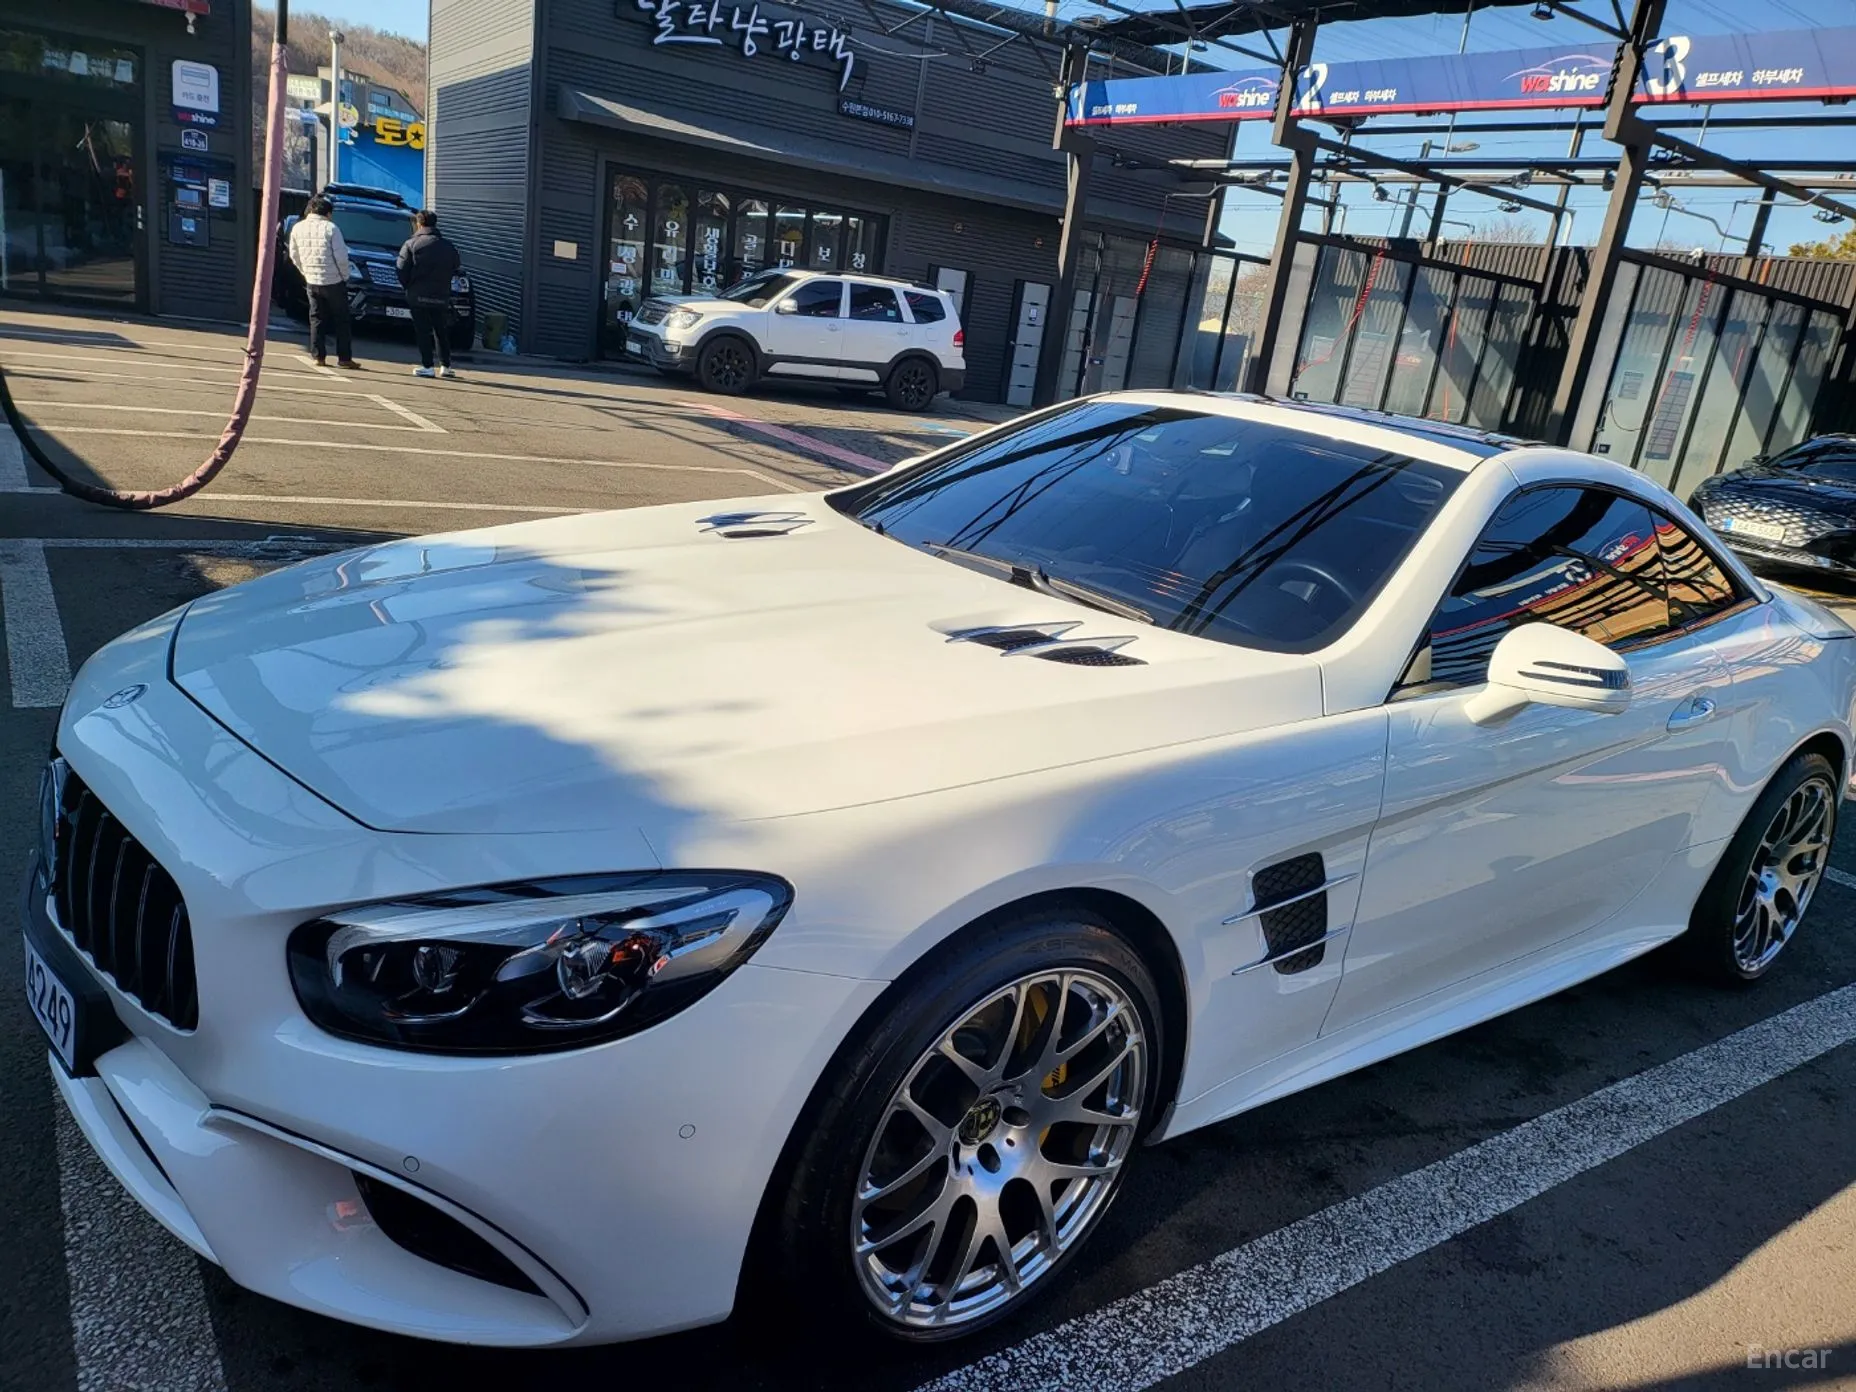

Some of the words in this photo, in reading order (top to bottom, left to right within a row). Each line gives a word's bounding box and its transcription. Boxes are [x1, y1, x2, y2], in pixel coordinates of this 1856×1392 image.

[1301, 63, 1328, 110] 2
[1521, 67, 1599, 95] washine
[1650, 36, 1690, 95] 3
[1695, 71, 1743, 87] 셀프세차
[1752, 68, 1804, 85] 하부세차
[1219, 86, 1270, 108] washine
[28, 953, 71, 1050] 4249
